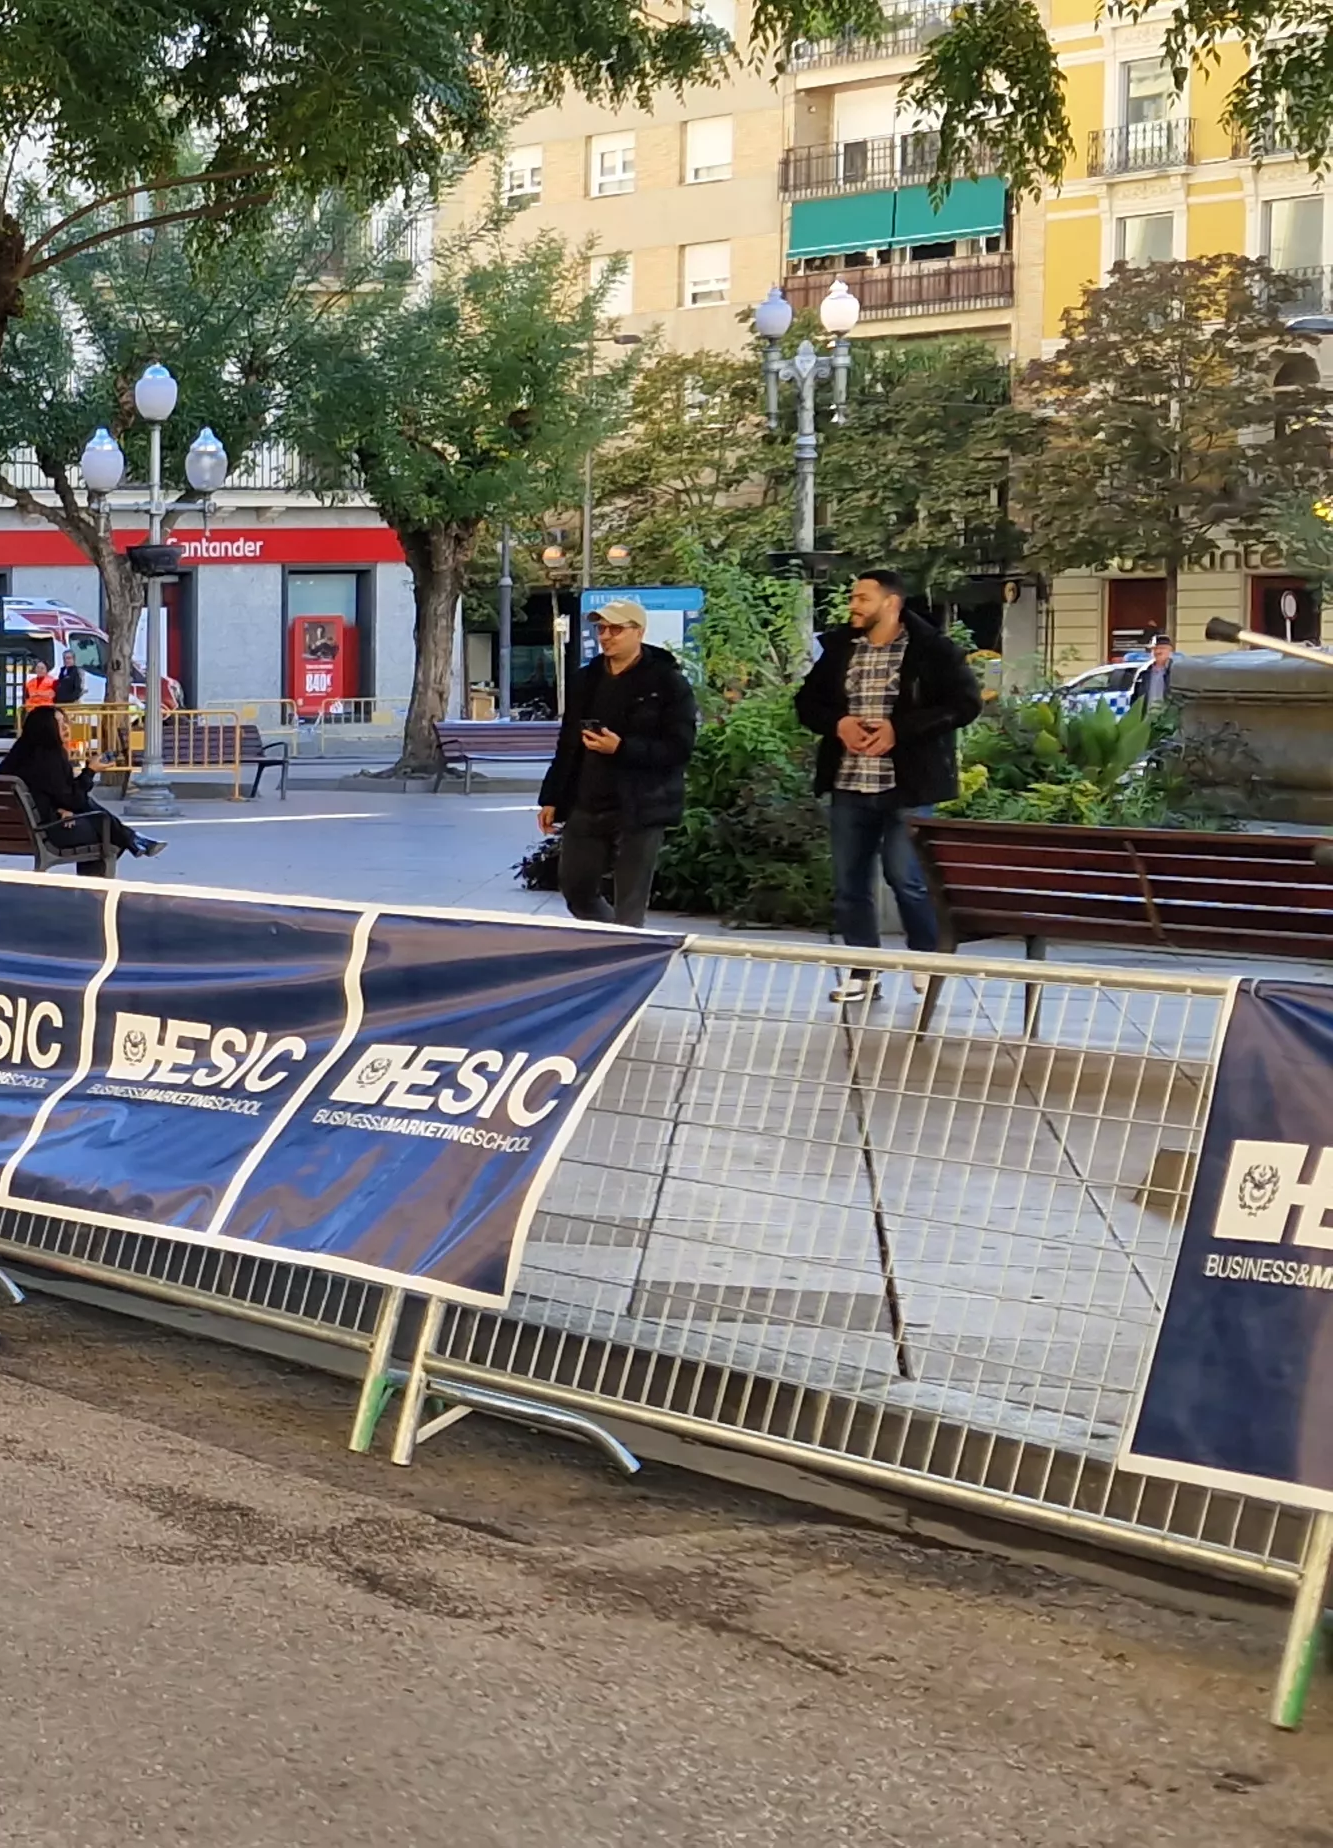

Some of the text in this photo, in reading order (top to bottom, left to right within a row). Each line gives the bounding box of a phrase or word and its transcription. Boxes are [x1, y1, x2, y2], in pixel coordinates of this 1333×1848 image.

[149, 1019, 306, 1093] ESIC
[382, 1045, 577, 1127] ESIC
[1204, 1253, 1333, 1290] BUSINESS&M
